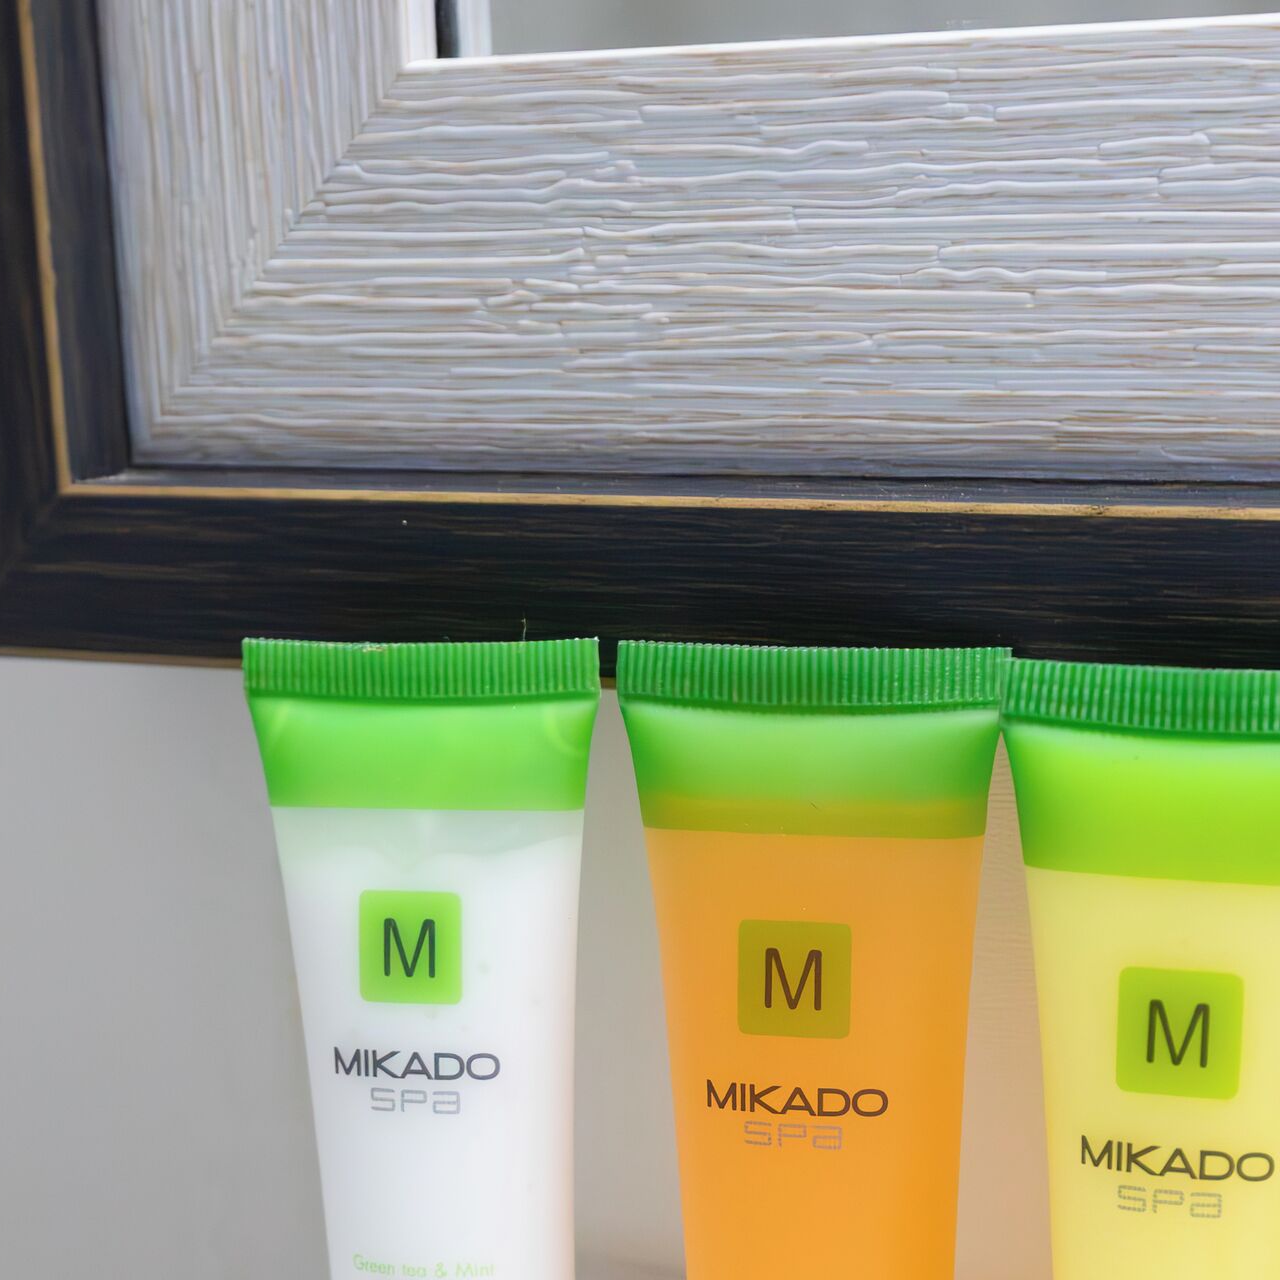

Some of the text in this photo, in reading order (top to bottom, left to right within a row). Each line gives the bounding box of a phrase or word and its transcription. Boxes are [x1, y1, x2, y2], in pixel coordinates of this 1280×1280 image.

[384, 918, 435, 978] M
[764, 947, 822, 1011] M
[1146, 999, 1210, 1068] M
[334, 1046, 501, 1080] MIKADO
[706, 1079, 889, 1117] MIKADO
[1081, 1134, 1275, 1182] MIKADO
[352, 1254, 497, 1278] Green tea & Mint
